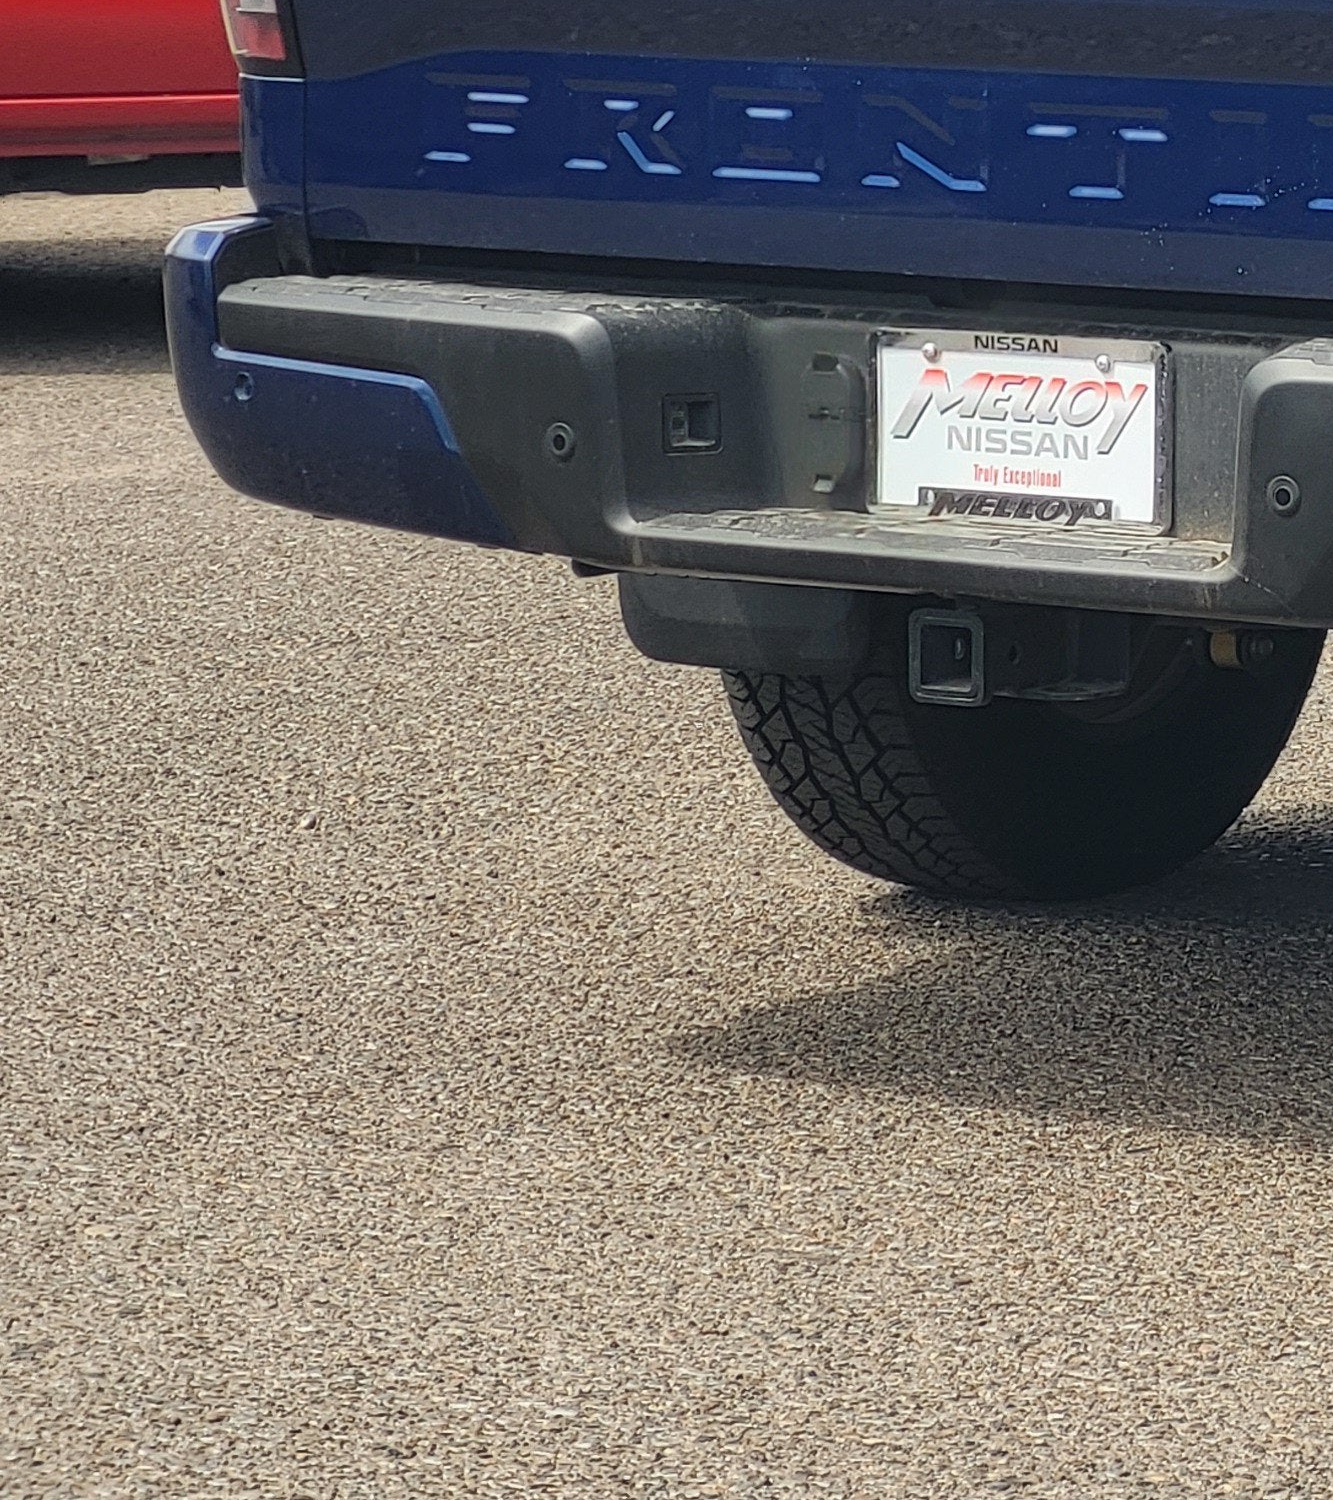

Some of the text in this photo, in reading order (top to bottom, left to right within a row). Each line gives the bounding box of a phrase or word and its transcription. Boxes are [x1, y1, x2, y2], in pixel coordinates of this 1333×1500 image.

[973, 334, 1059, 353] NISSAN
[890, 368, 1148, 455] MELLOY
[947, 425, 1089, 460] NISSAN
[974, 464, 1062, 488] Truly Exceptional
[928, 489, 1088, 527] MELLOY
